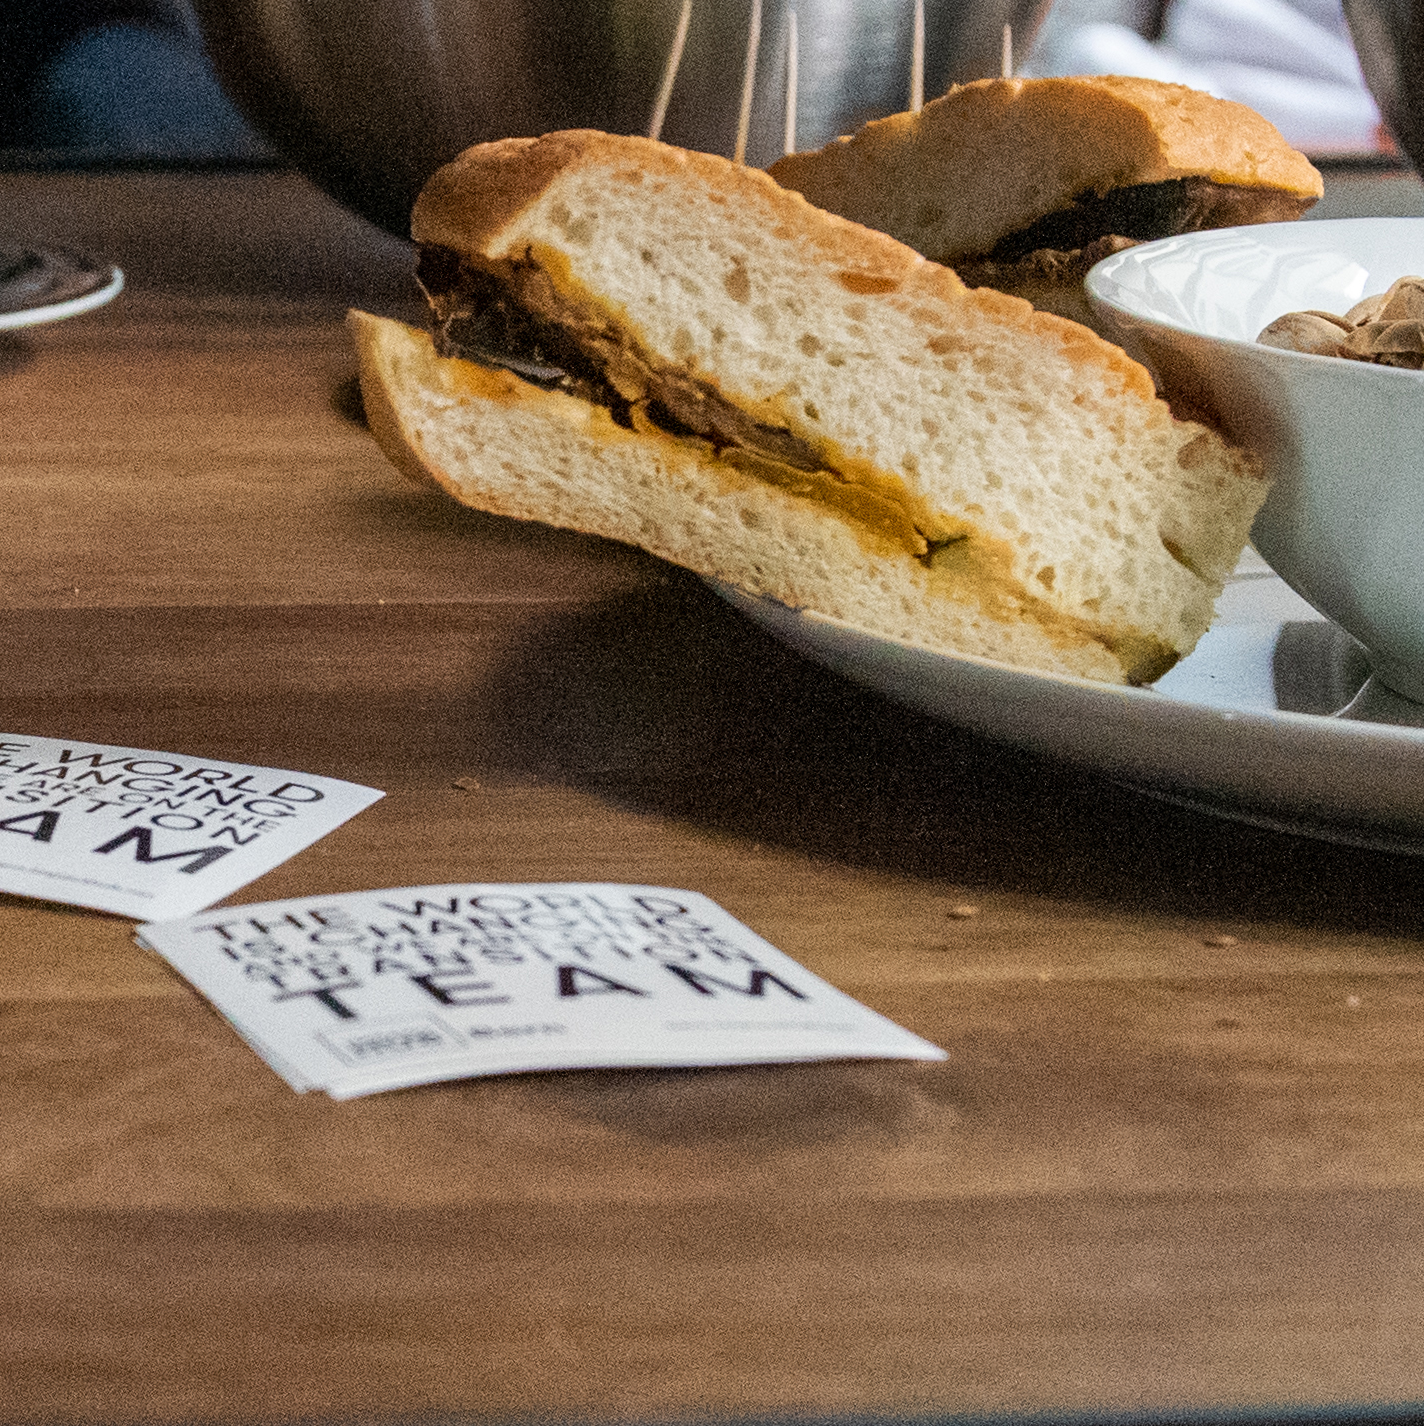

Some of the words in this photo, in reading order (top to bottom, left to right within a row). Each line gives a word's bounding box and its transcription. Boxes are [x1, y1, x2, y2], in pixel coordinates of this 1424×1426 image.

[58, 749, 325, 803] WORLD
[191, 906, 353, 942] THE
[378, 893, 689, 917] WORLD
[270, 963, 811, 1020] TEAM
